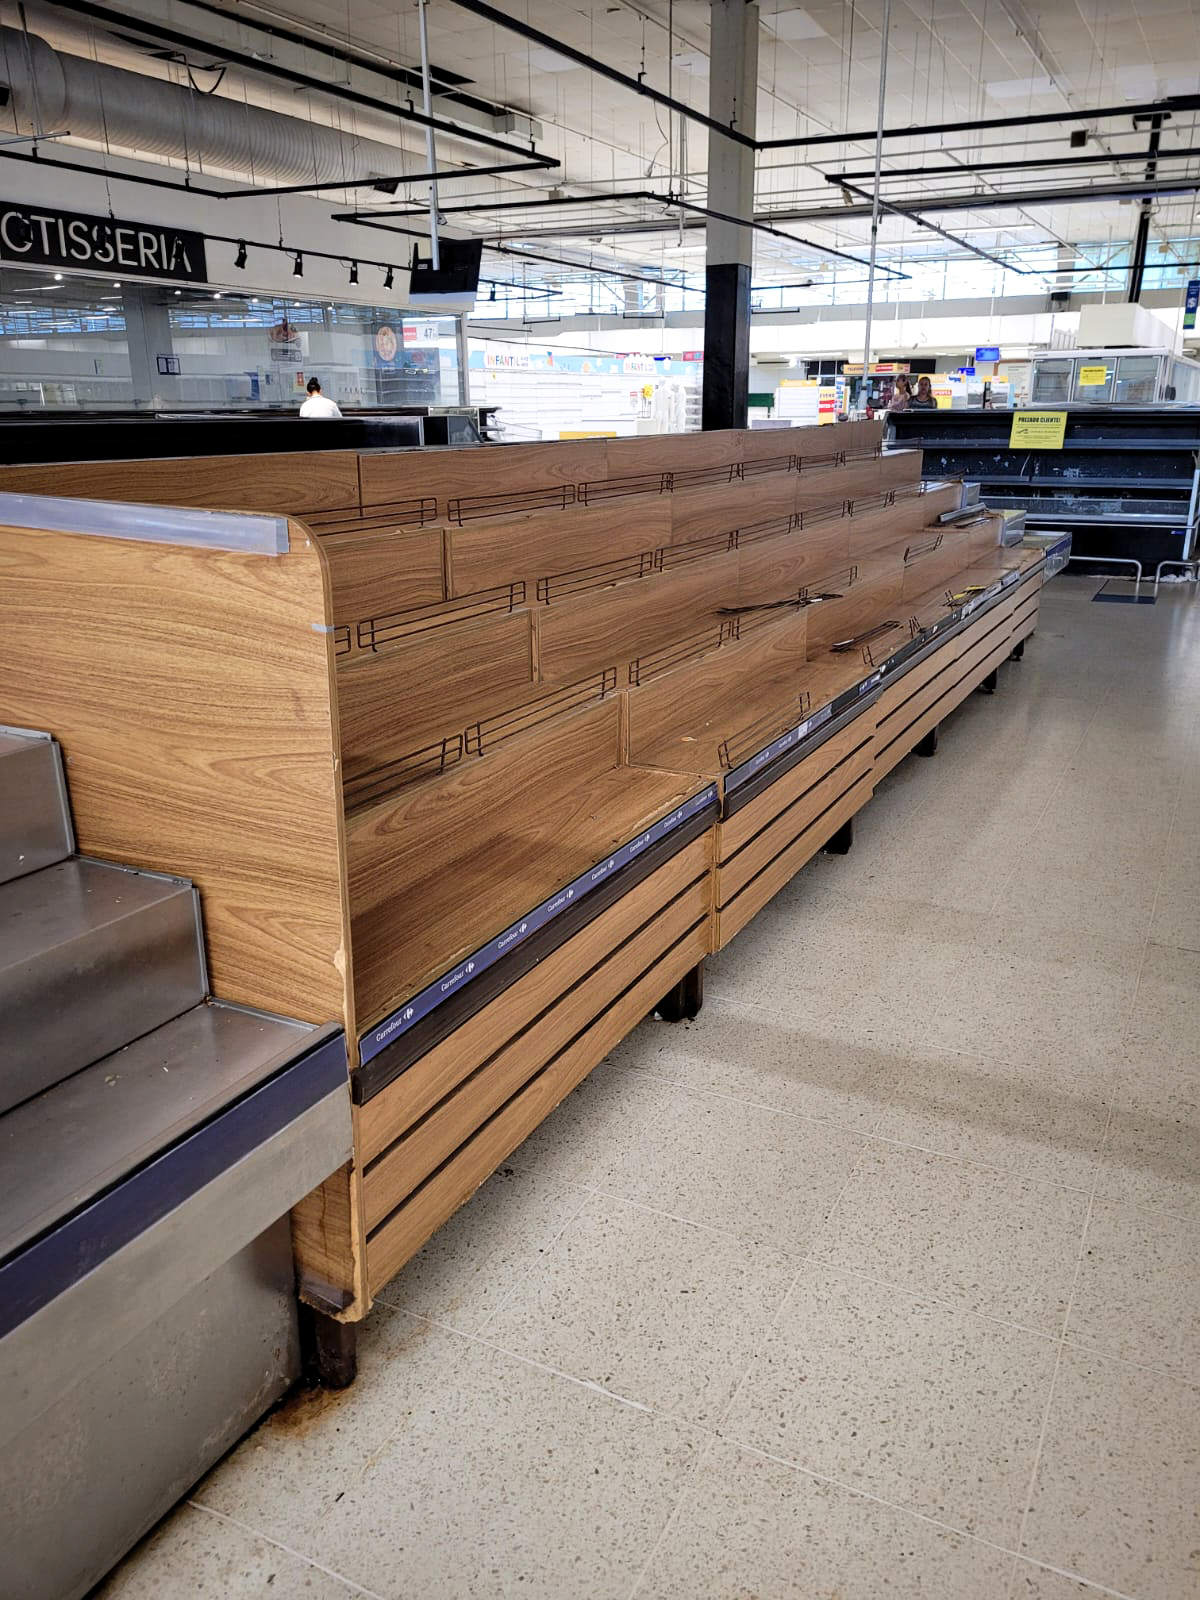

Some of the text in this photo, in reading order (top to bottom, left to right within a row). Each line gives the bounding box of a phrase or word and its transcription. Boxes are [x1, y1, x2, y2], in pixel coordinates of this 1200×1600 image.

[487, 355, 520, 367] INFANTIL
[497, 930, 519, 950] Carrefour
[441, 971, 464, 992] Carrefour
[375, 1016, 402, 1042] Carrefour
